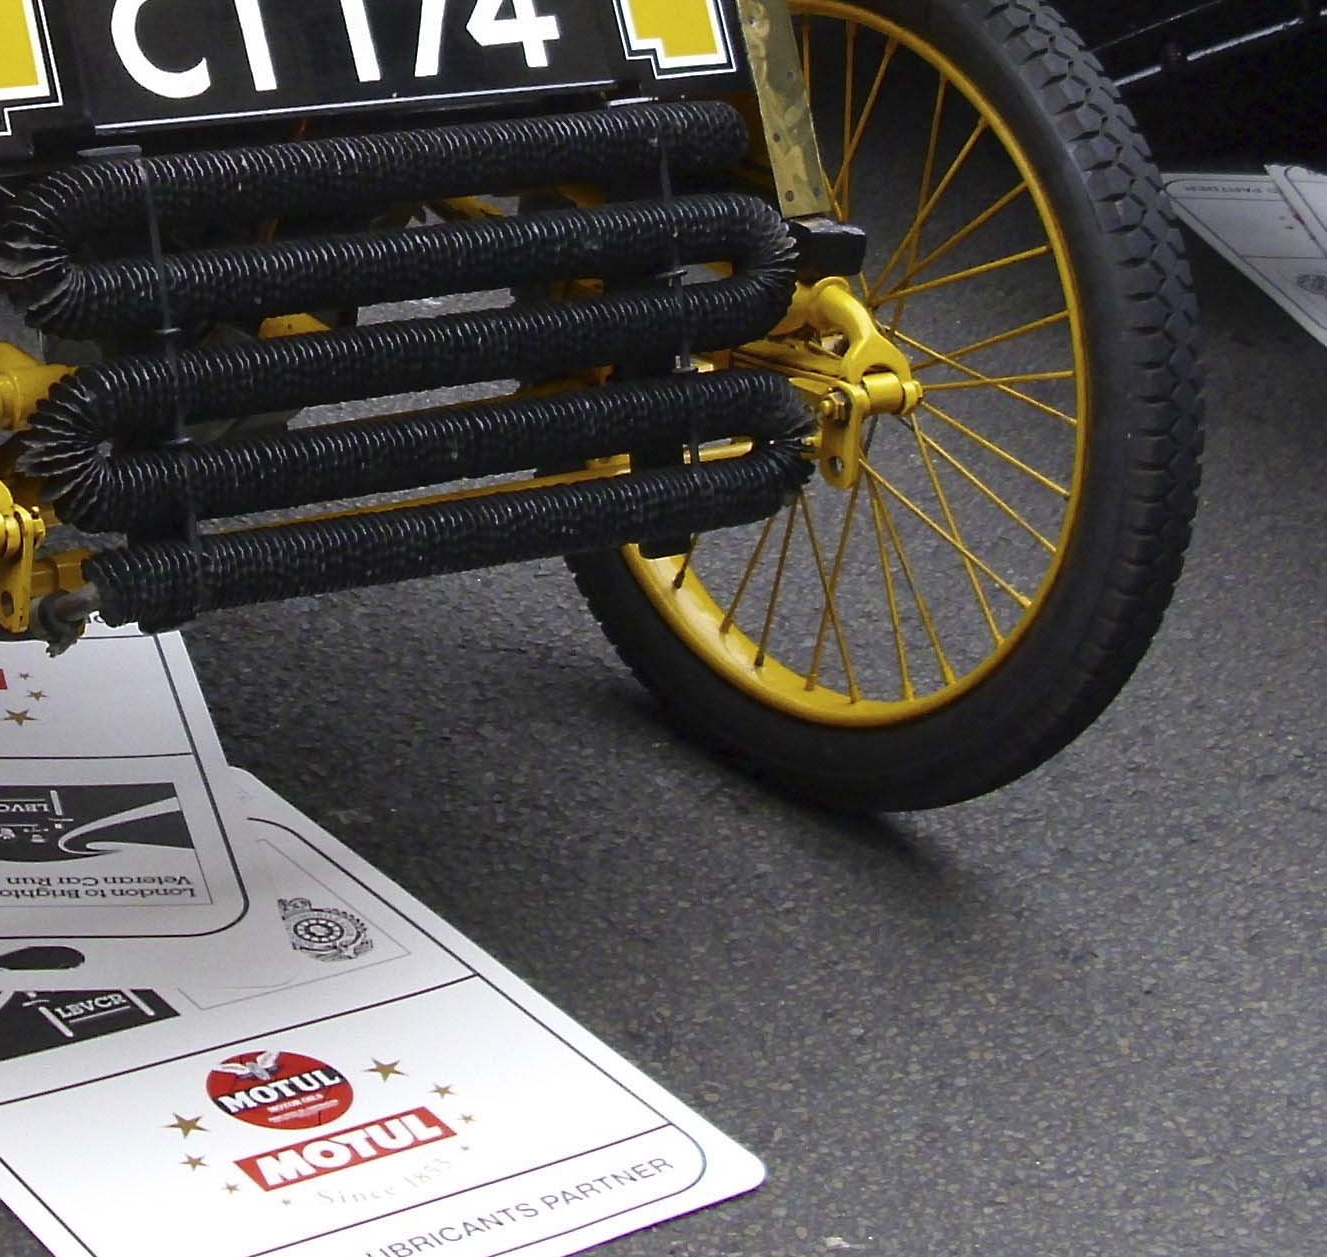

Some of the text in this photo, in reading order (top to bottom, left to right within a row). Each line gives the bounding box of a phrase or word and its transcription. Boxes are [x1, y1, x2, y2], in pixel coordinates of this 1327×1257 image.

[6, 875, 194, 886] Veteran Car Run
[85, 888, 107, 898] to
[111, 888, 195, 898] London
[54, 993, 127, 1019] LBVCR
[217, 1069, 341, 1114] MOTUL
[255, 1113, 444, 1187] MOTUL
[539, 1157, 675, 1211] PARTNER
